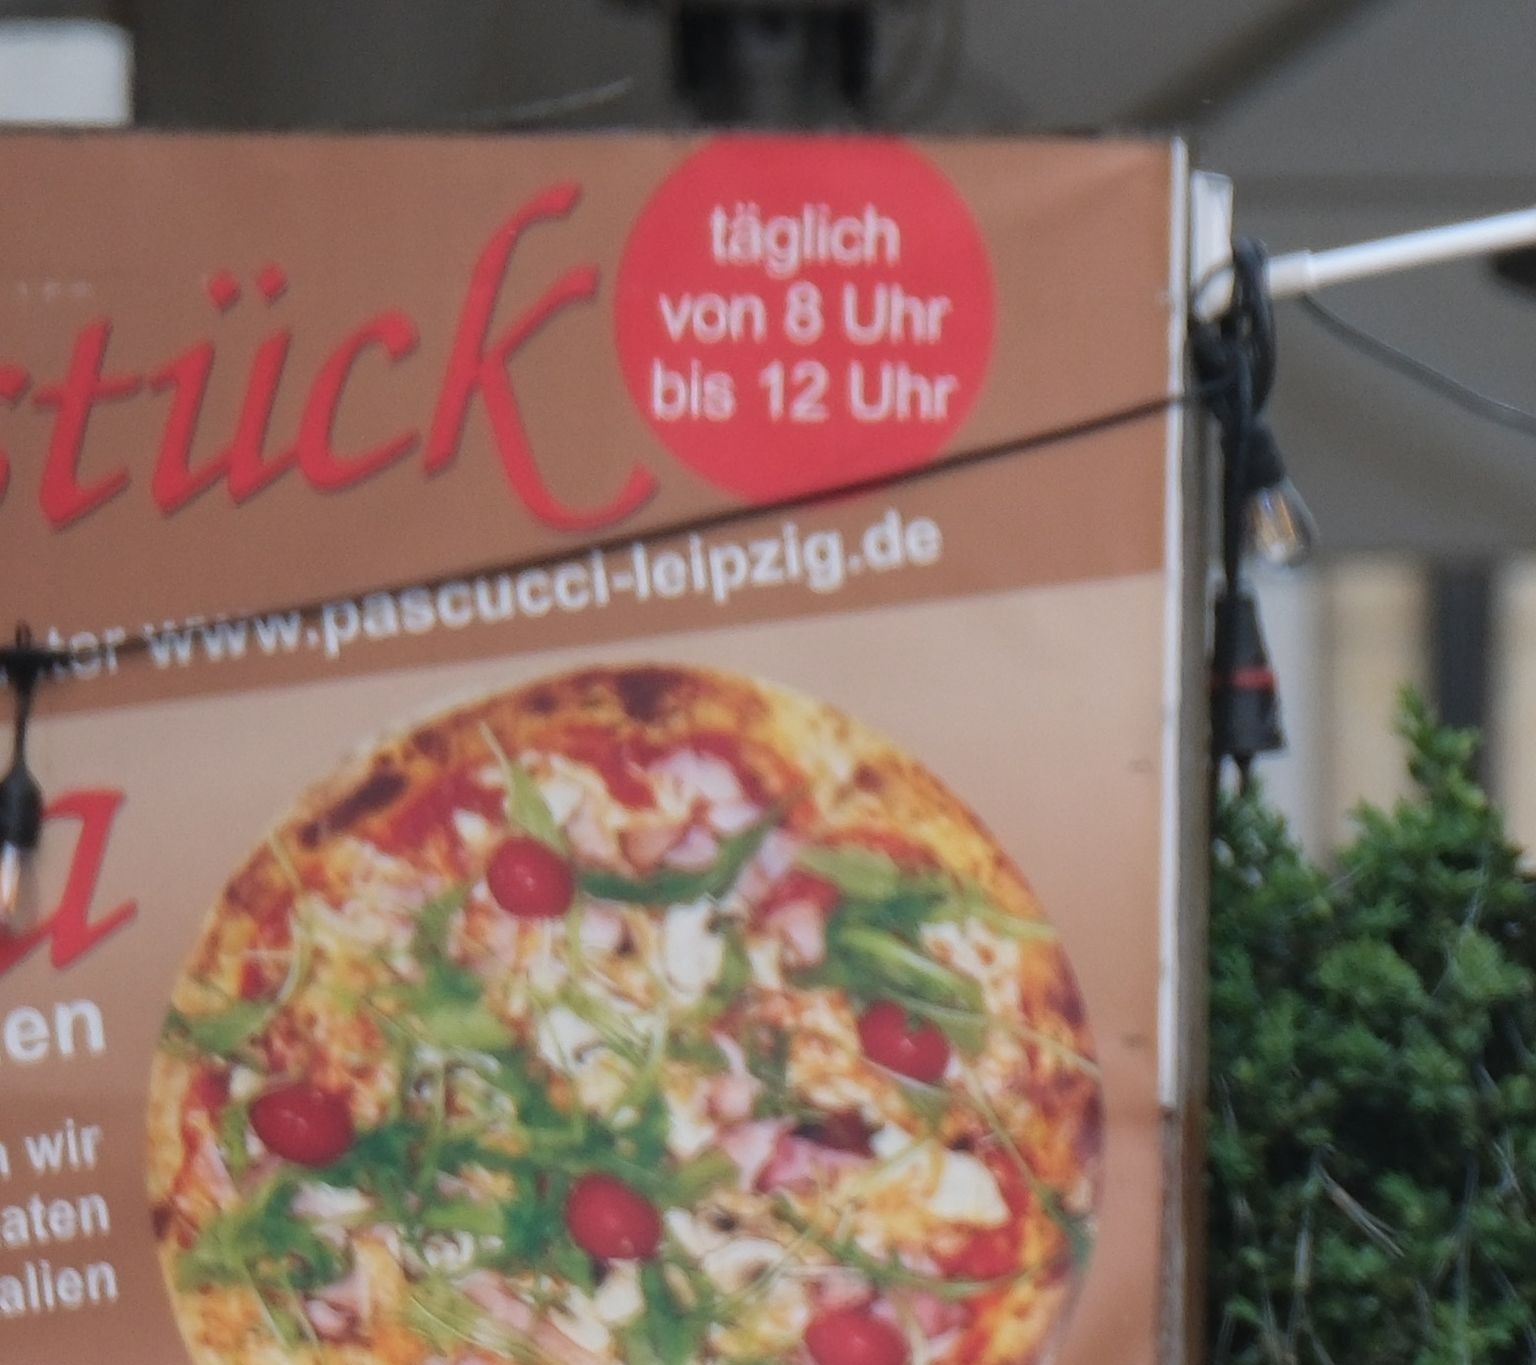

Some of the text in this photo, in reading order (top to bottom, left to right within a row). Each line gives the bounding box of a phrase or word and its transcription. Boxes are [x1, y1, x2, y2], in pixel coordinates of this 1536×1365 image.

[711, 201, 900, 279] täglich
[659, 281, 952, 344] von 8 Uhr
[0, 176, 658, 532] tück
[652, 358, 959, 422] bis 12 Uhr
[145, 508, 943, 668] www.pascucci-leipzig.de
[25, 1117, 101, 1174] wir
